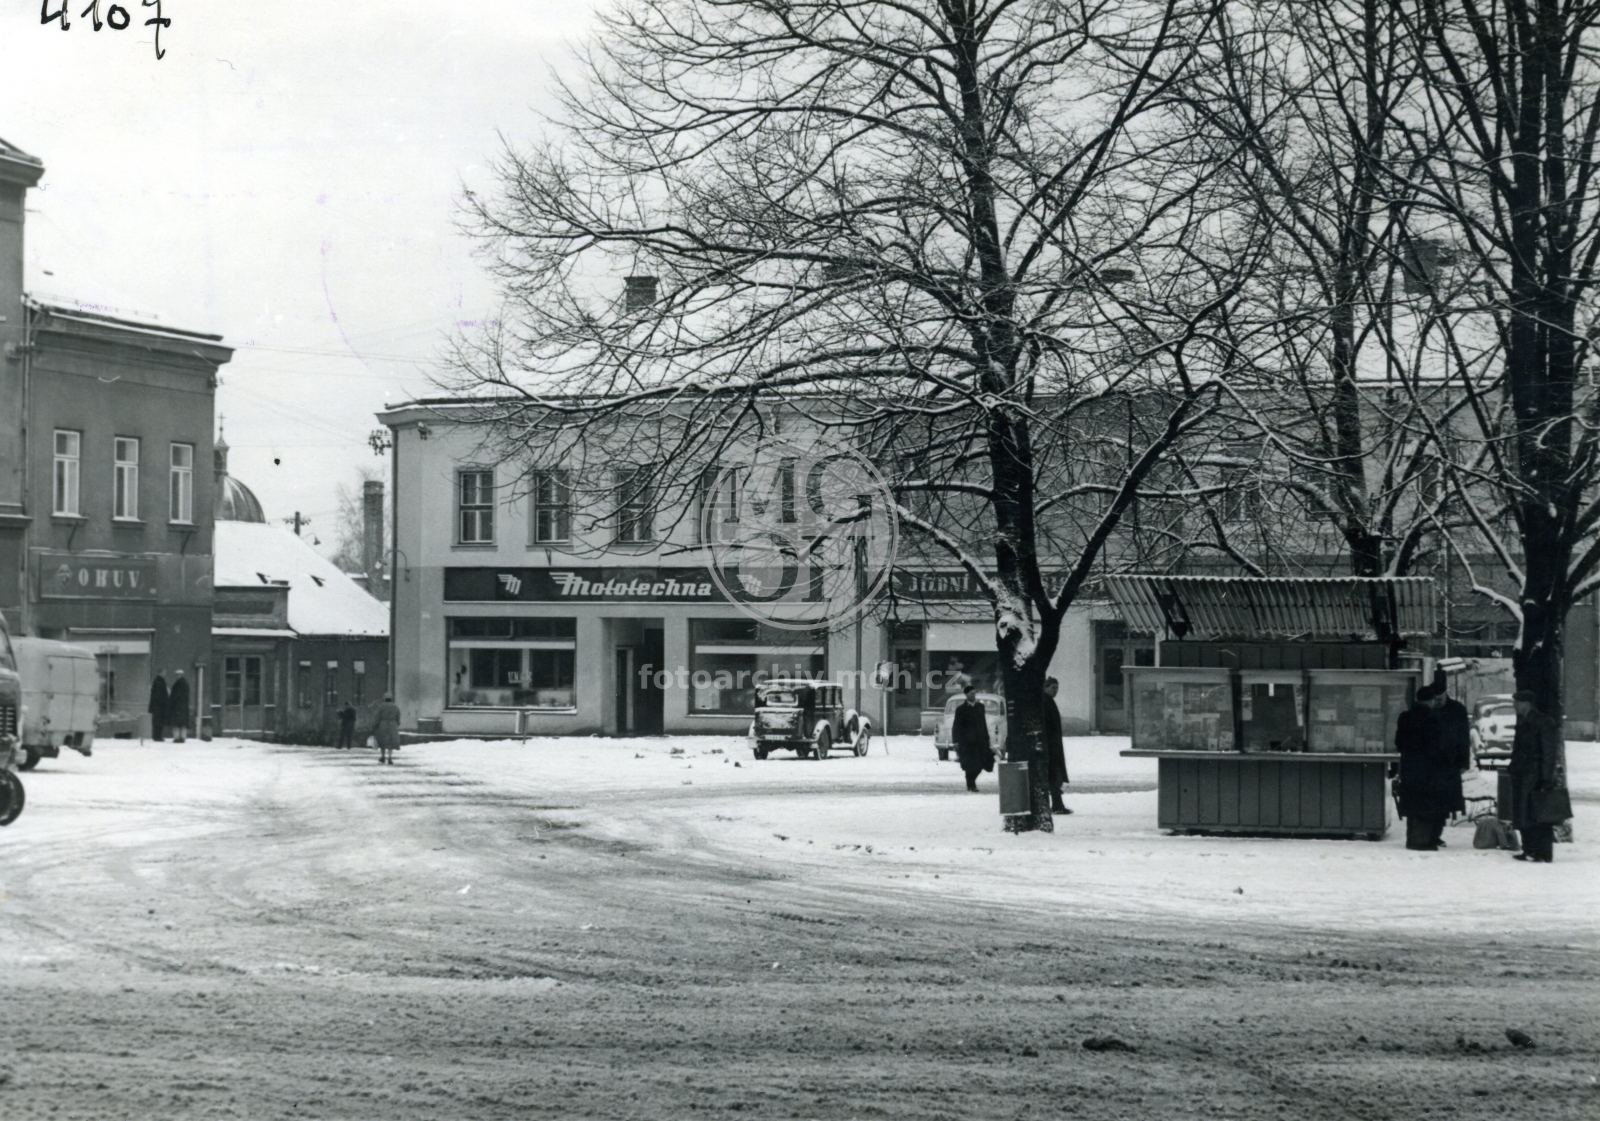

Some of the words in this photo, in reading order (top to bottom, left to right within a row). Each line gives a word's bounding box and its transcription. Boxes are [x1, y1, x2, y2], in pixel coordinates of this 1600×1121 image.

[41, 0, 171, 60] 4107
[78, 567, 141, 588] OBUV
[549, 571, 712, 596] Mototechna
[908, 573, 970, 592] JÍZDNÍ
